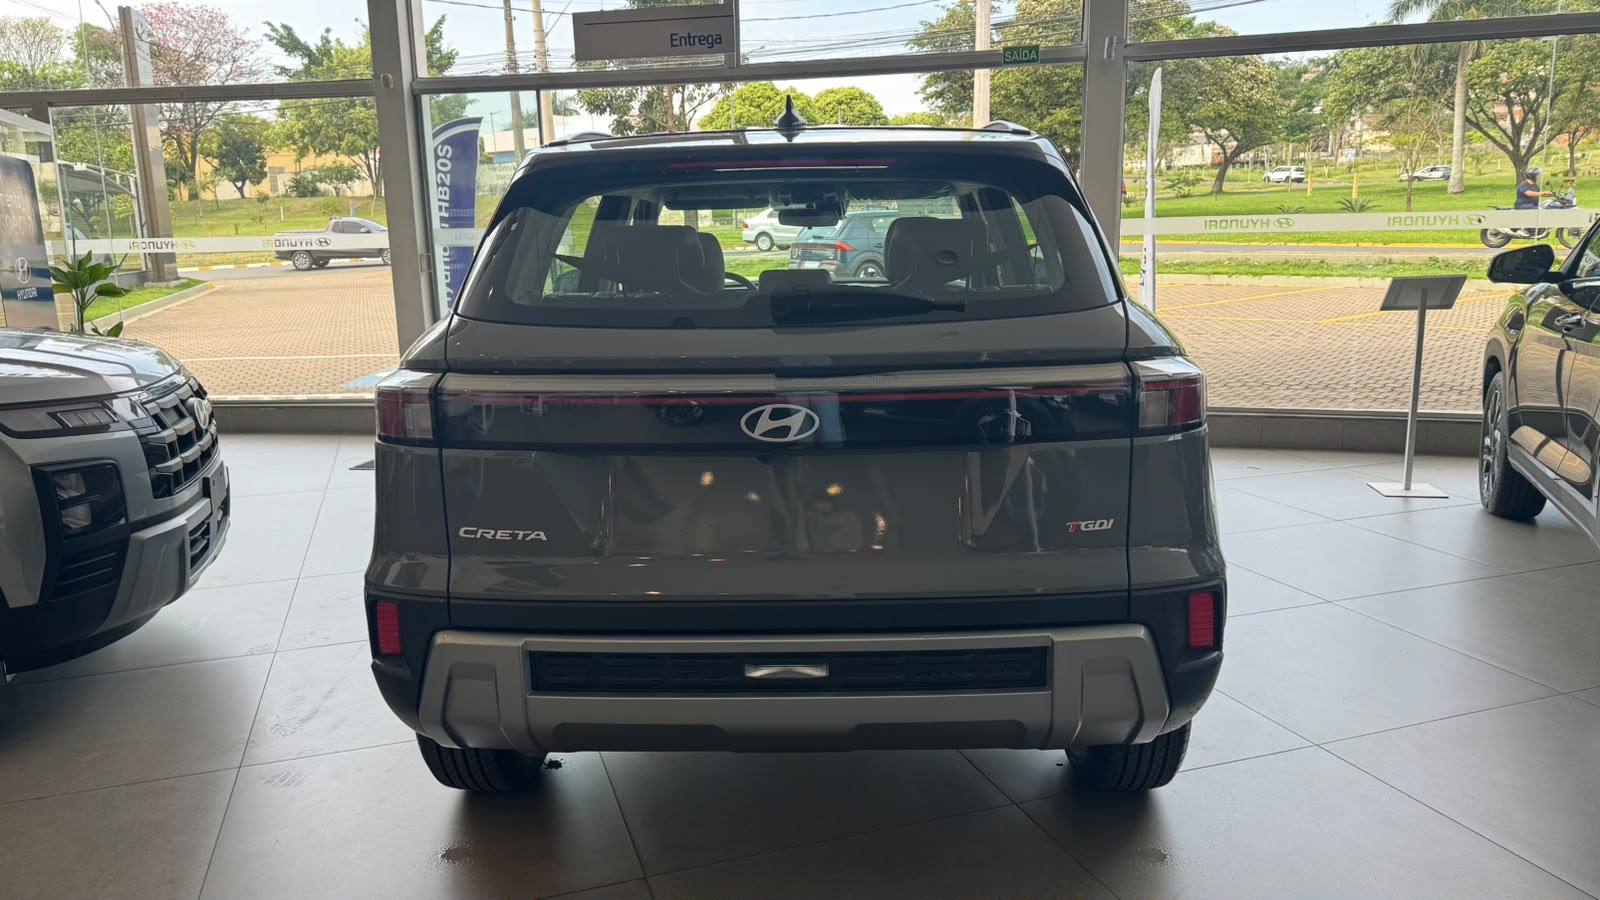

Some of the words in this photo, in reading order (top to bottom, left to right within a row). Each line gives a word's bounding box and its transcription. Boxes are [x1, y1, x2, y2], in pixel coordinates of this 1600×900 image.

[670, 33, 722, 48] Entrega
[1005, 48, 1037, 61] SAÍDA
[437, 143, 453, 217] HB20S
[16, 287, 38, 300] HYUNDAI
[459, 526, 548, 541] CRETA
